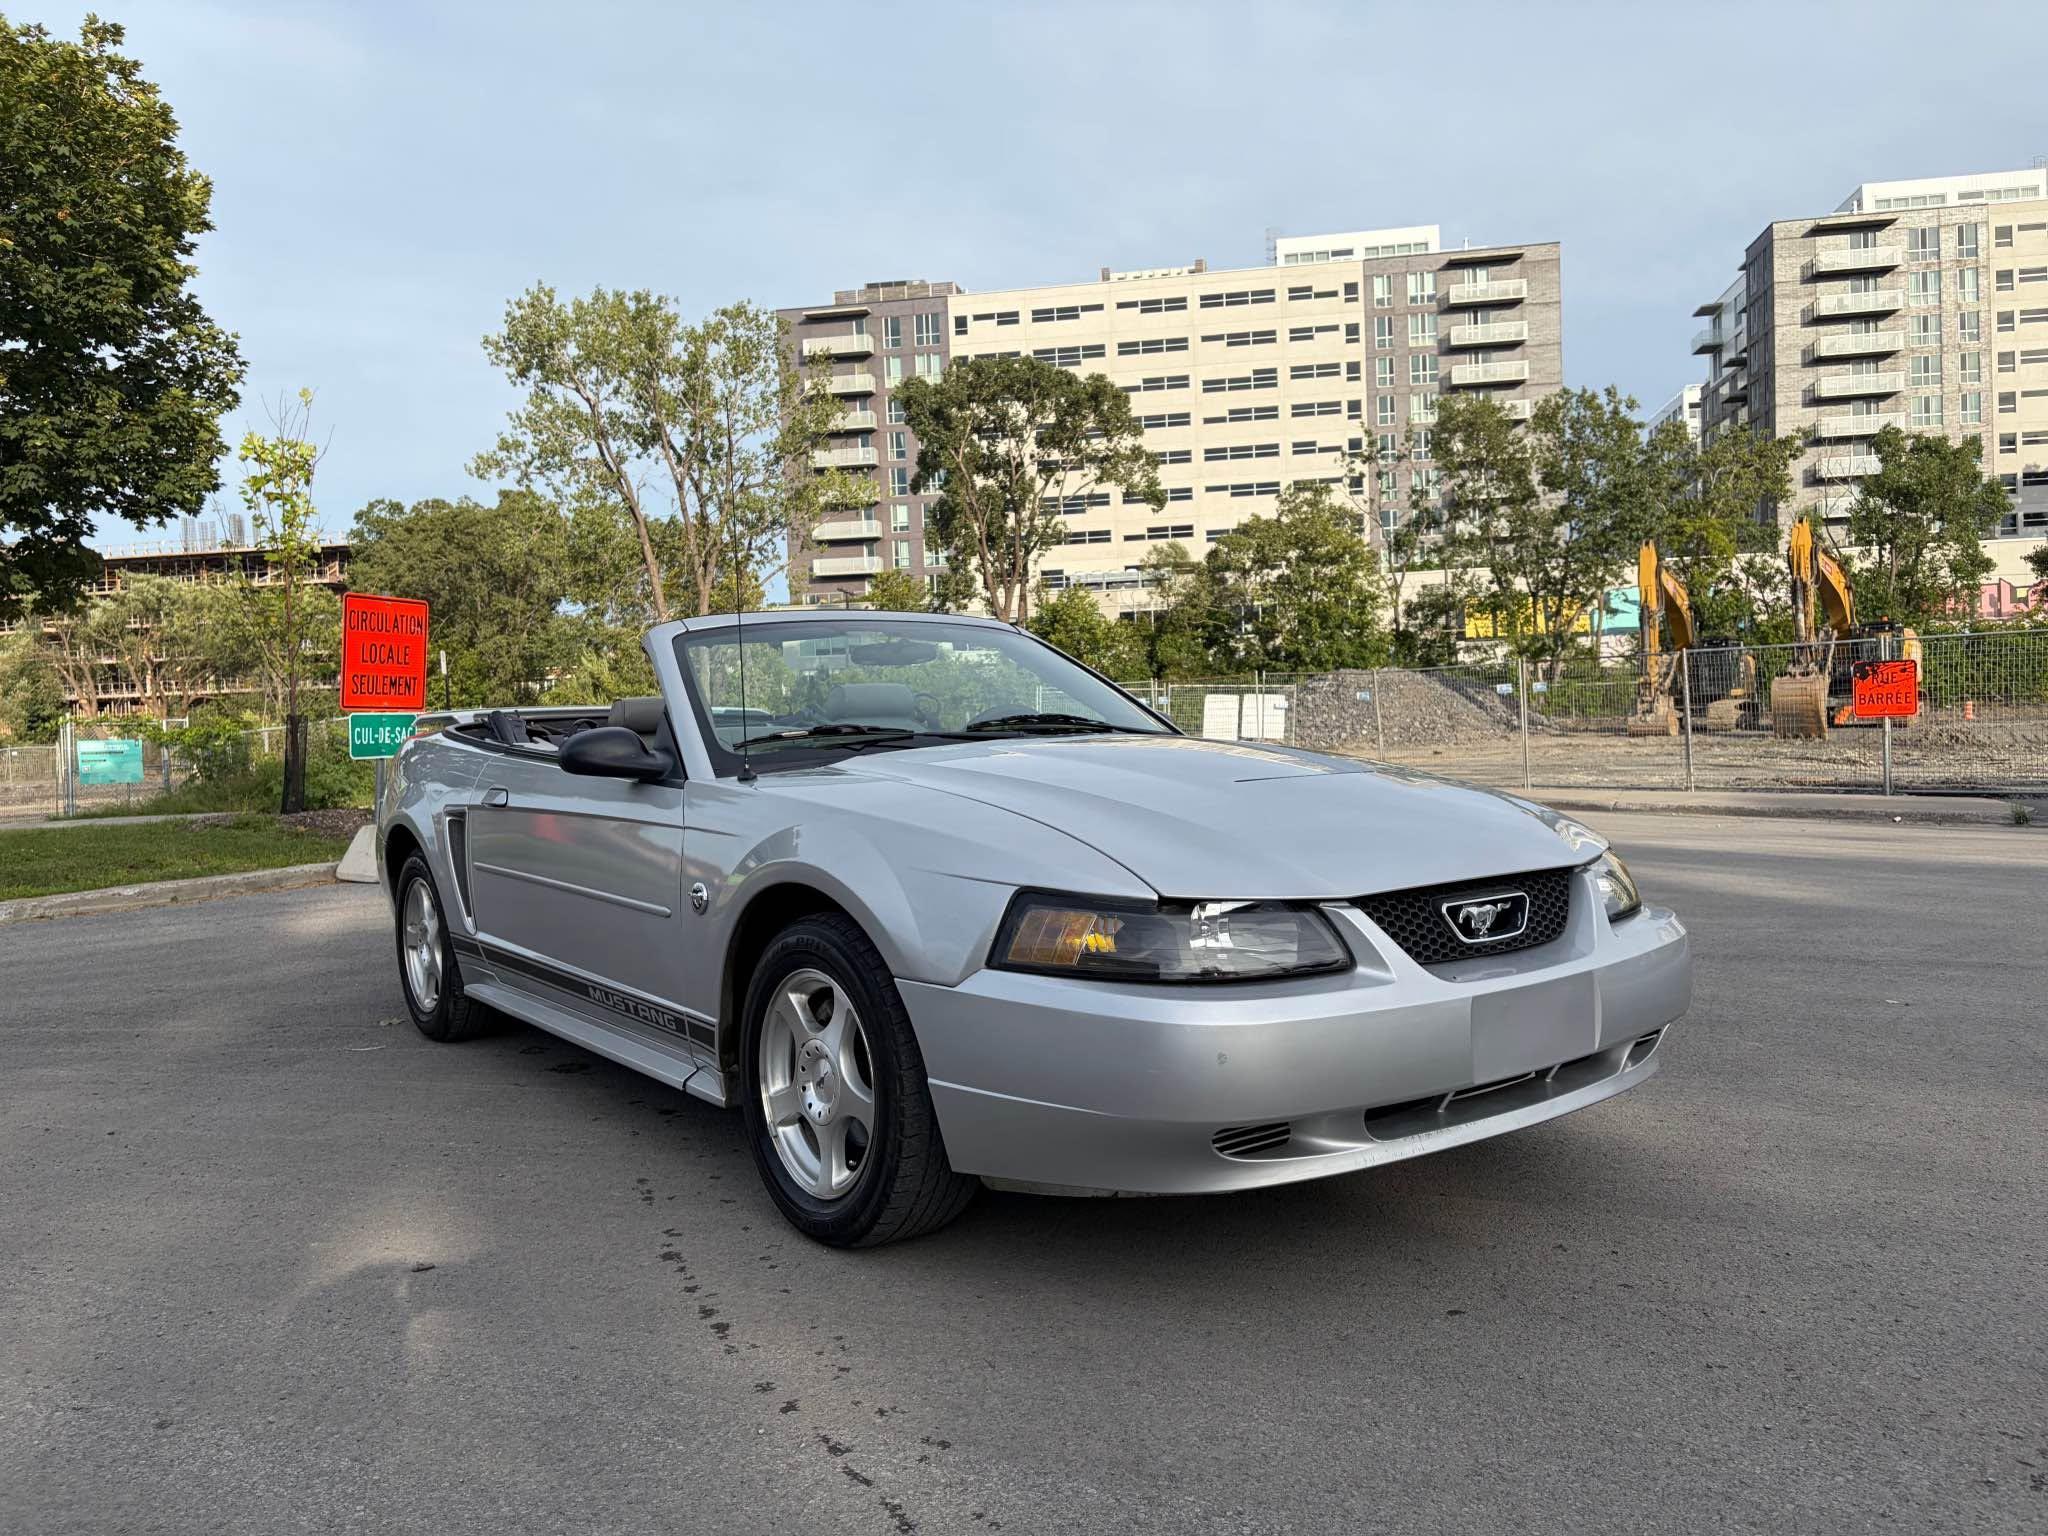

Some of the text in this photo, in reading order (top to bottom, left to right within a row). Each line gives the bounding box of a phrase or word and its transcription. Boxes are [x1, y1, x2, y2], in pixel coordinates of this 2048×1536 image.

[349, 610, 423, 635] CIRCULATION
[362, 643, 410, 665] LOCALE
[351, 675, 417, 697] SEULEMENT
[1872, 671, 1898, 685] RUE
[1859, 690, 1912, 705] BARRÉE
[588, 986, 677, 1030] MUSTANG
